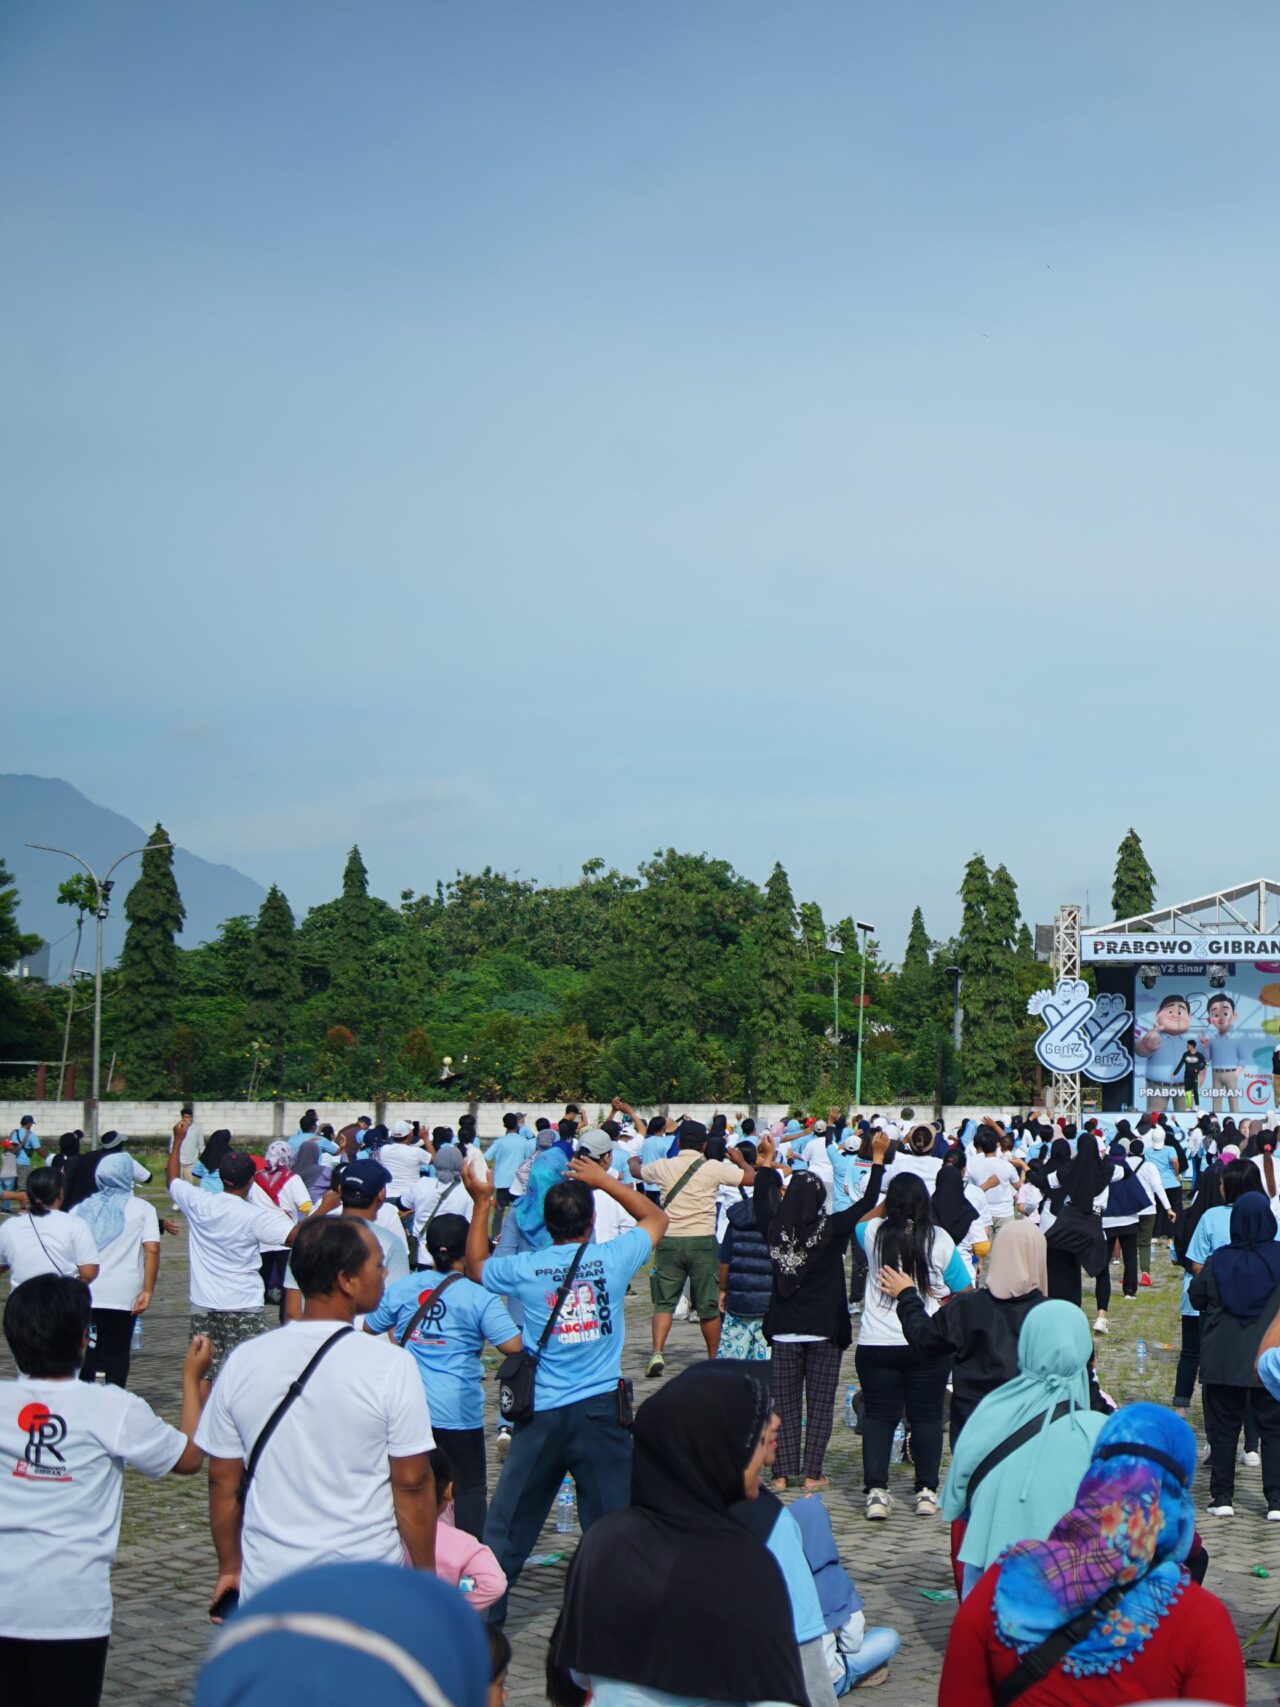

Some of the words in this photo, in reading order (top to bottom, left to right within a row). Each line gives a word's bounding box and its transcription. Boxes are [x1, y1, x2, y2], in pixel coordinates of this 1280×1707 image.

[1093, 940, 1193, 955] PRABOWO
[1177, 963, 1204, 973] Sinar
[1200, 1088, 1243, 1098] GIBRAN
[552, 1267, 604, 1282] GIRAN
[594, 1277, 613, 1336] 2024
